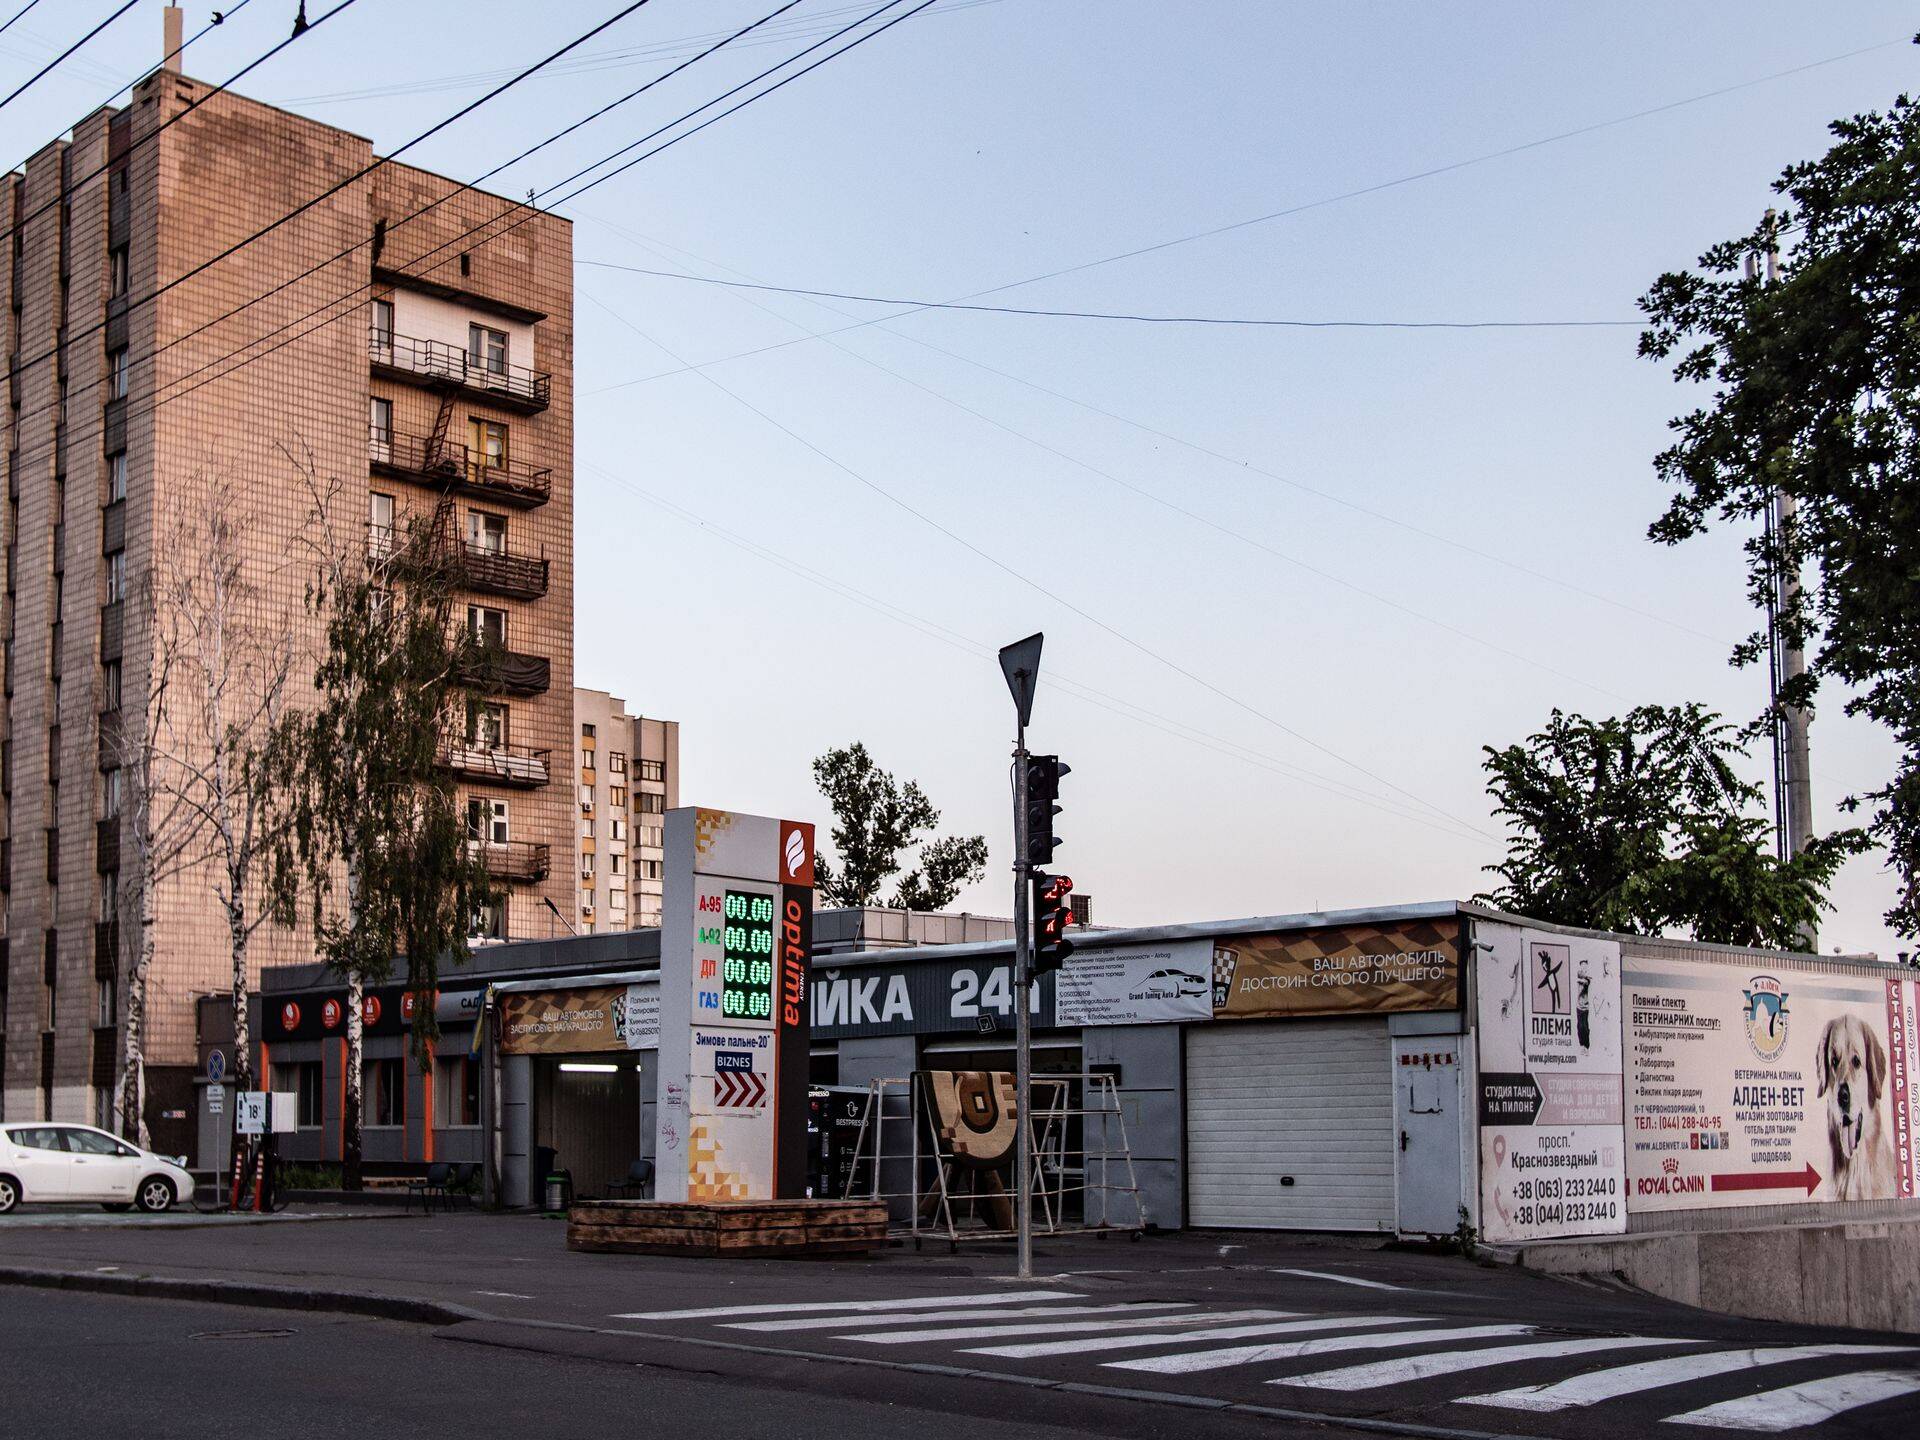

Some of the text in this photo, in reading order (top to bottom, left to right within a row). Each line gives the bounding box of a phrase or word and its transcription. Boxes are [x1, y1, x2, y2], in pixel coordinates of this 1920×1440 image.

[699, 895, 721, 913] А-95
[725, 894, 773, 922] 00.00
[698, 927, 721, 944] А-92
[725, 926, 772, 953] 00.00
[701, 959, 716, 979] ДП
[782, 899, 804, 1026] optima
[1314, 950, 1446, 972] ВАШ АВТОМОБИЛЬ
[724, 958, 771, 984] 00.00
[1240, 966, 1446, 993] ДОСТОИН САМОГО ЛУЧШЕГО!
[698, 991, 719, 1009] ГАЗ
[723, 989, 771, 1016] 00.00
[811, 969, 914, 1027] ЙКА
[1128, 992, 1144, 1000] Grand
[1632, 993, 1686, 1010] Повний спектр
[543, 1009, 604, 1022] ВАШ АВТОМОБІЛЬ
[1633, 1011, 1721, 1030] ВЕТЕРИНАРНИХ послуг:
[1532, 1017, 1572, 1036] ПЛЕМЯ
[696, 1032, 726, 1047] Зимове
[1532, 1037, 1572, 1048] студия танца
[717, 1056, 751, 1068] BIZNES
[1528, 1052, 1577, 1066] www.plemya.com
[1734, 1069, 1802, 1080] ВЕТЕРИНАРНА КЛІНІКА
[1485, 1085, 1537, 1100] СТУДИЯ ТАНЦА
[1733, 1086, 1805, 1110] АЛДЕН-ВЕТ
[1891, 984, 1910, 1193] СТАРТЕР СЕРВІС
[1488, 1101, 1534, 1113] НА ПИЛОНЕ
[1735, 1111, 1804, 1121] МАГАЗИН ЗООТОВАРІВ
[1635, 1115, 1722, 1131] ТЕЛ.: (044) 288-40-95
[1538, 1135, 1571, 1152] просп.
[1511, 1150, 1598, 1172] Краснозвездный
[1513, 1181, 1532, 1199] +38
[1534, 1177, 1563, 1201] (063)
[1565, 1179, 1585, 1197] 233
[1637, 1174, 1705, 1195] ROYAL CANIN
[1513, 1206, 1533, 1224] +38
[1536, 1202, 1563, 1226] (044)
[1566, 1203, 1585, 1221] 233
